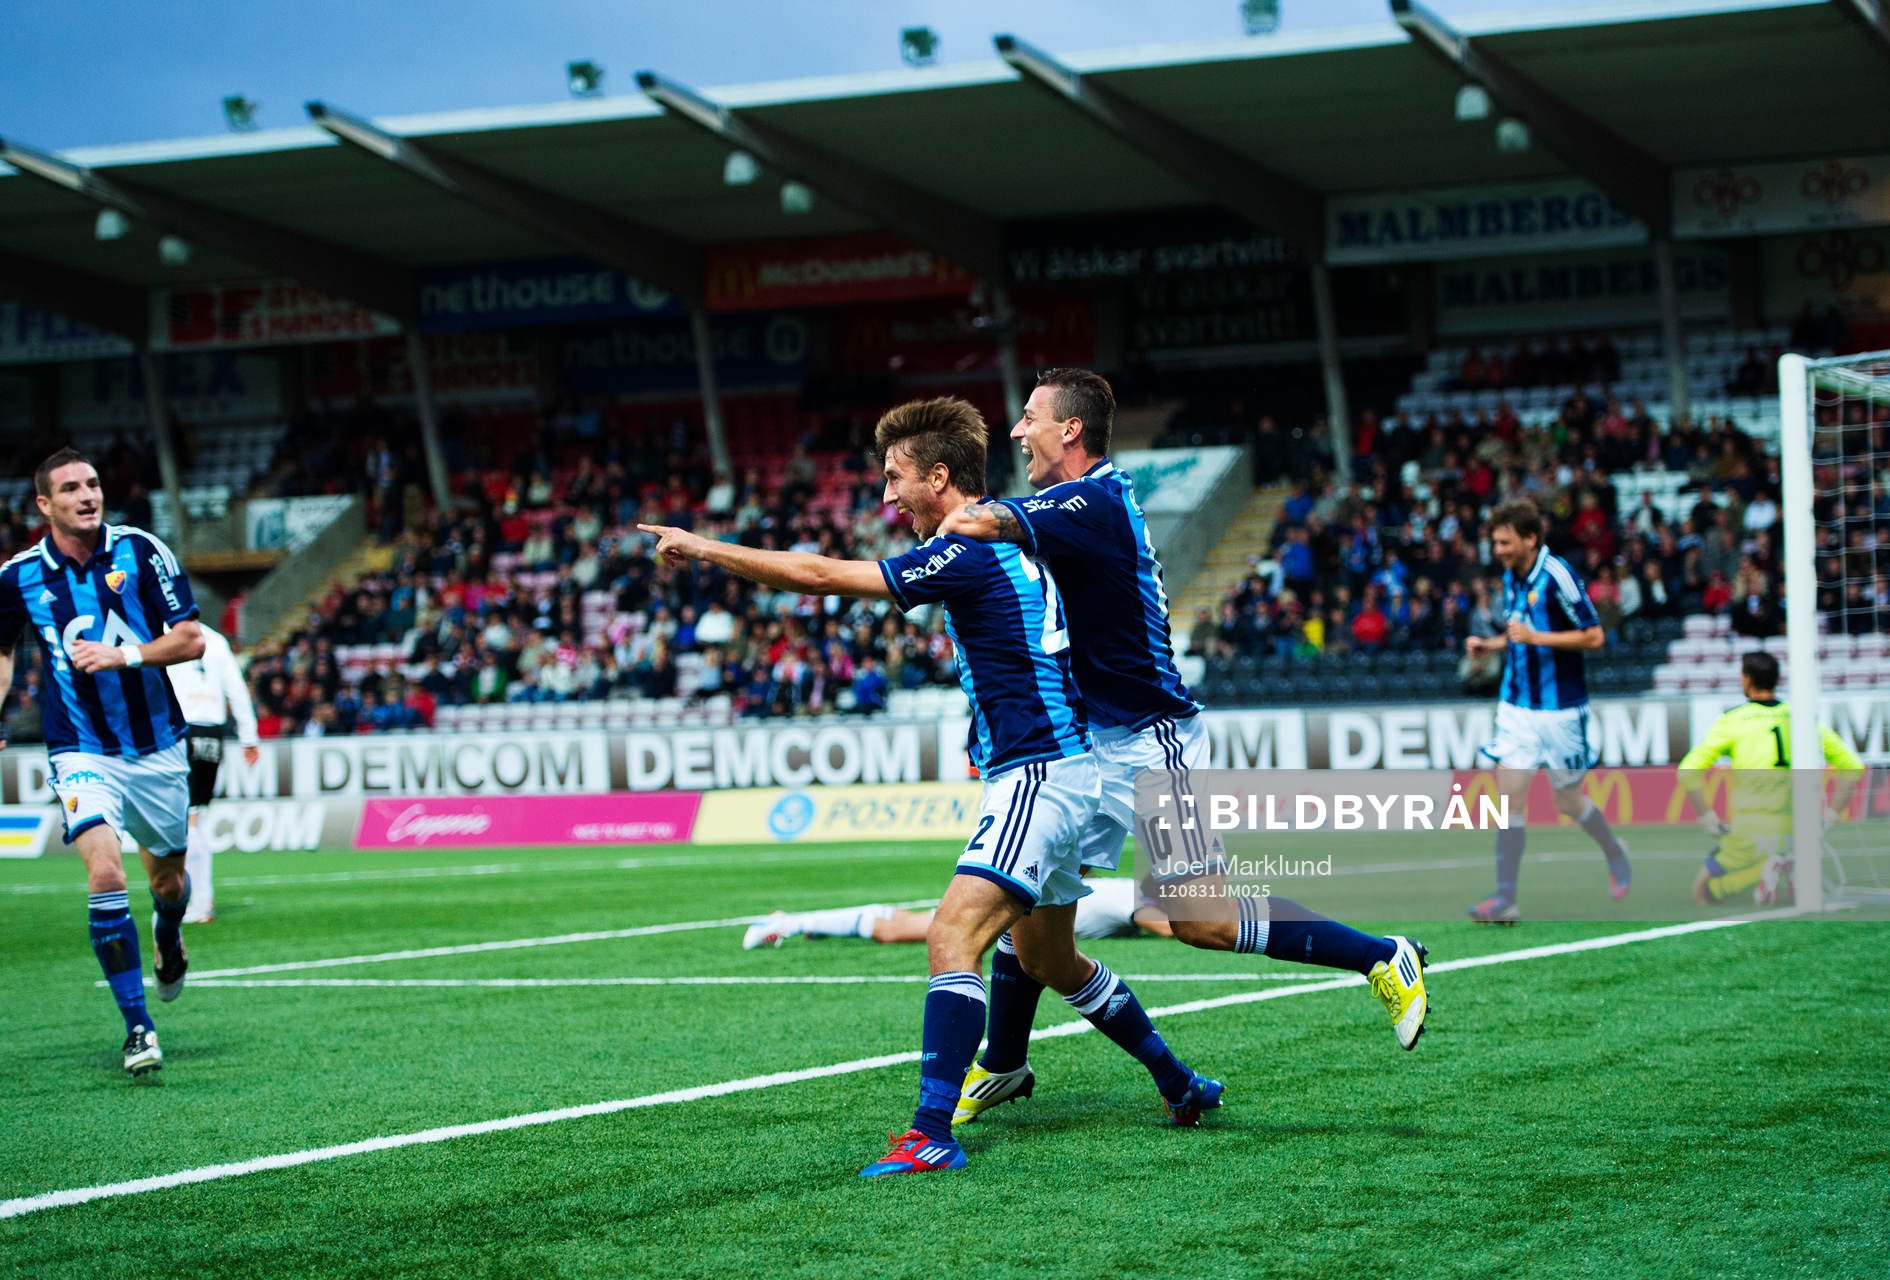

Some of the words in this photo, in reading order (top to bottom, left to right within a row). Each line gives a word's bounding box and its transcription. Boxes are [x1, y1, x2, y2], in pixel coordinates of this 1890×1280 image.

[1339, 195, 1634, 247] MALMBERGS
[757, 249, 935, 288] McDonald's
[1008, 247, 1041, 282] Vi
[1045, 239, 1143, 281] älskar
[420, 269, 616, 316] nethouse
[901, 542, 967, 584] Stadium
[319, 743, 585, 793] DEMCOM
[626, 726, 920, 791] DEMCOM
[1769, 726, 1791, 767] 1
[206, 801, 326, 853] COM
[826, 793, 972, 831] POSTEN
[922, 1052, 938, 1062] IF
